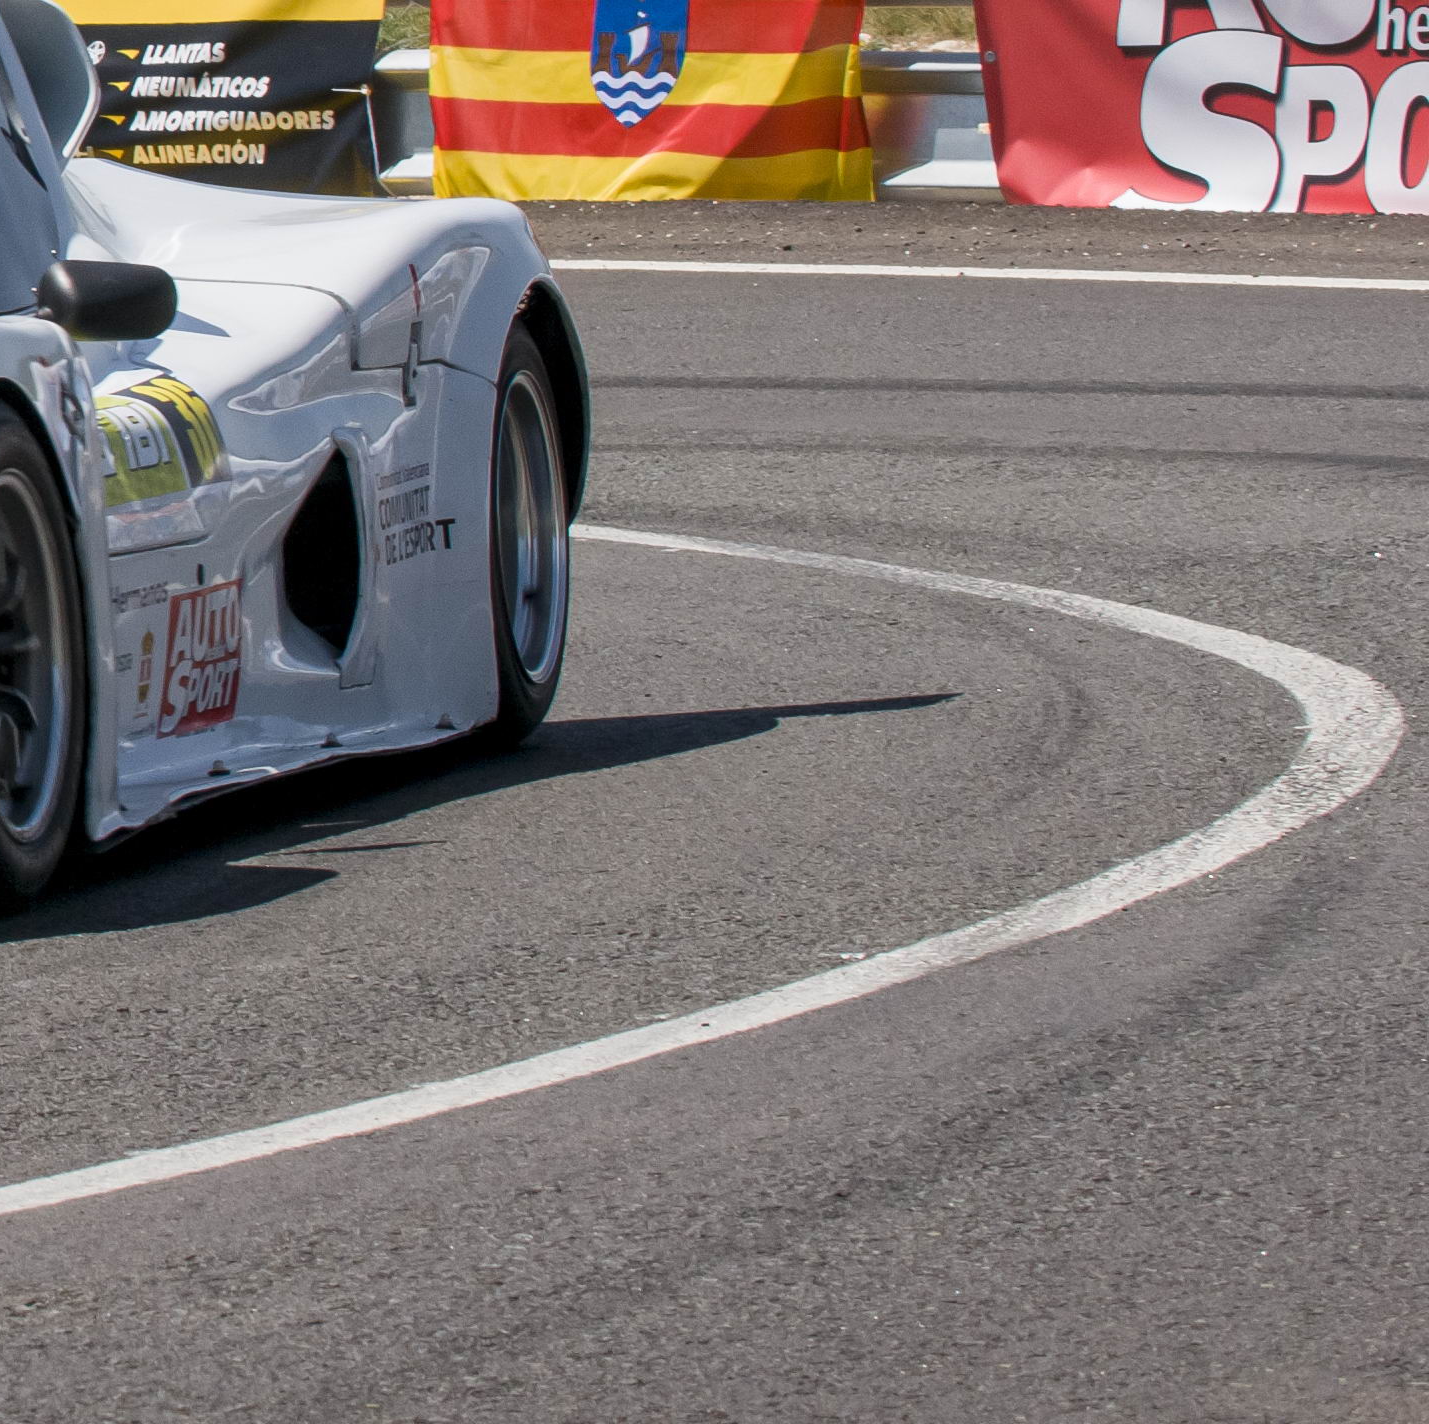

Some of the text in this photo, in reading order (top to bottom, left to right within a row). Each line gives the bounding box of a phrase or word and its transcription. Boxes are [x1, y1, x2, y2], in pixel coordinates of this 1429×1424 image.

[141, 42, 226, 65] LLANTAS
[131, 72, 271, 98] NEUMÁTICOS
[129, 110, 336, 131] AMORTIGUADORES
[132, 139, 266, 165] ALINEACIÓN
[169, 585, 240, 668] AUTO
[159, 659, 240, 734] SPORT
